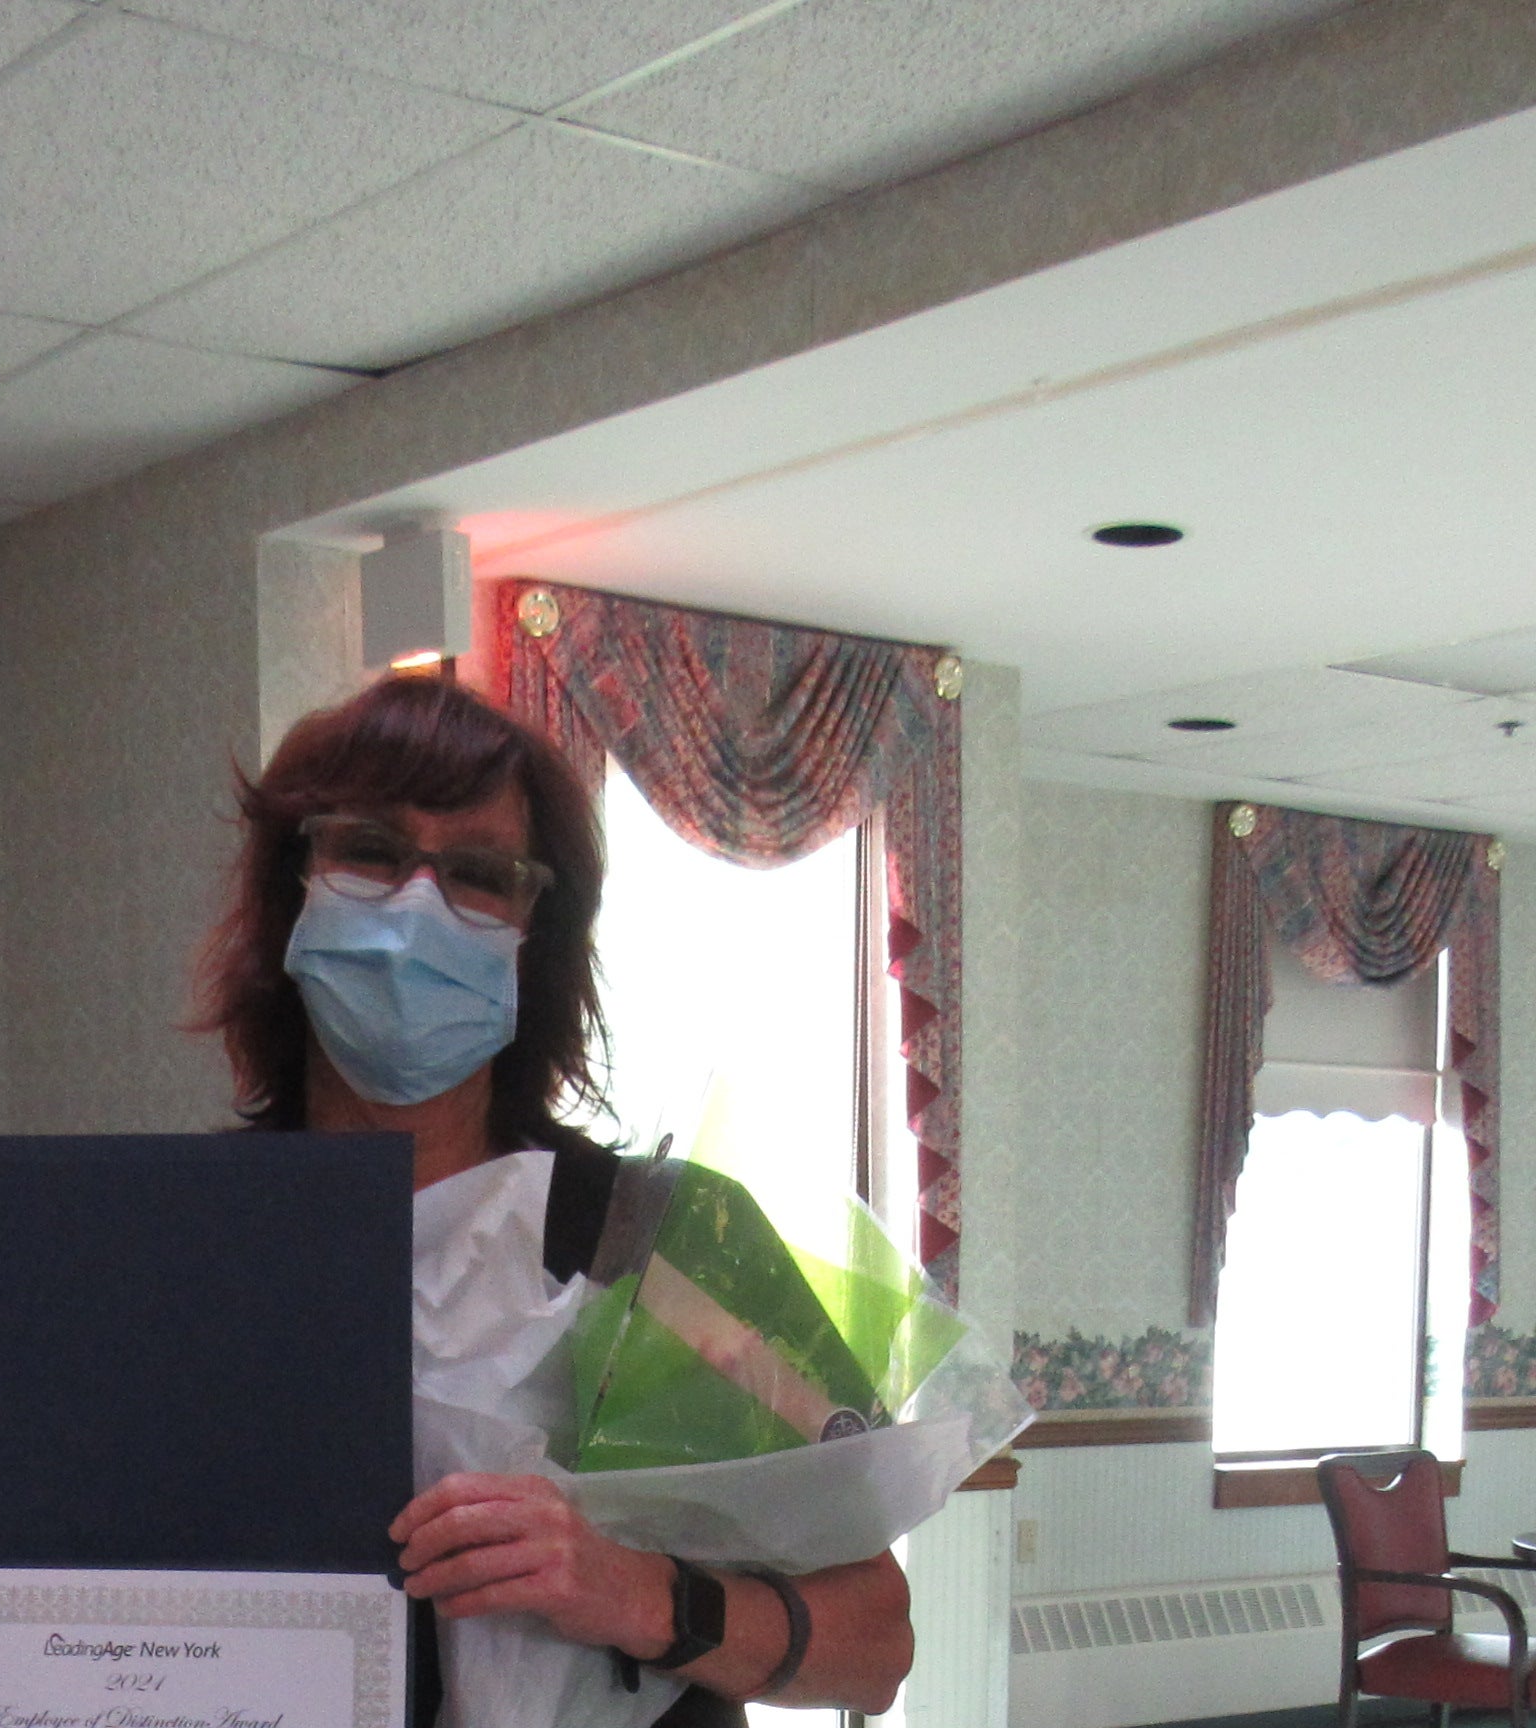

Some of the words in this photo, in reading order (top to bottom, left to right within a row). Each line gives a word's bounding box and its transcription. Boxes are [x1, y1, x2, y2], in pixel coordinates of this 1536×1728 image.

[44, 1633, 134, 1661] LeadingAge
[140, 1641, 181, 1658] New
[184, 1641, 222, 1658] York
[104, 1673, 167, 1691] 2021
